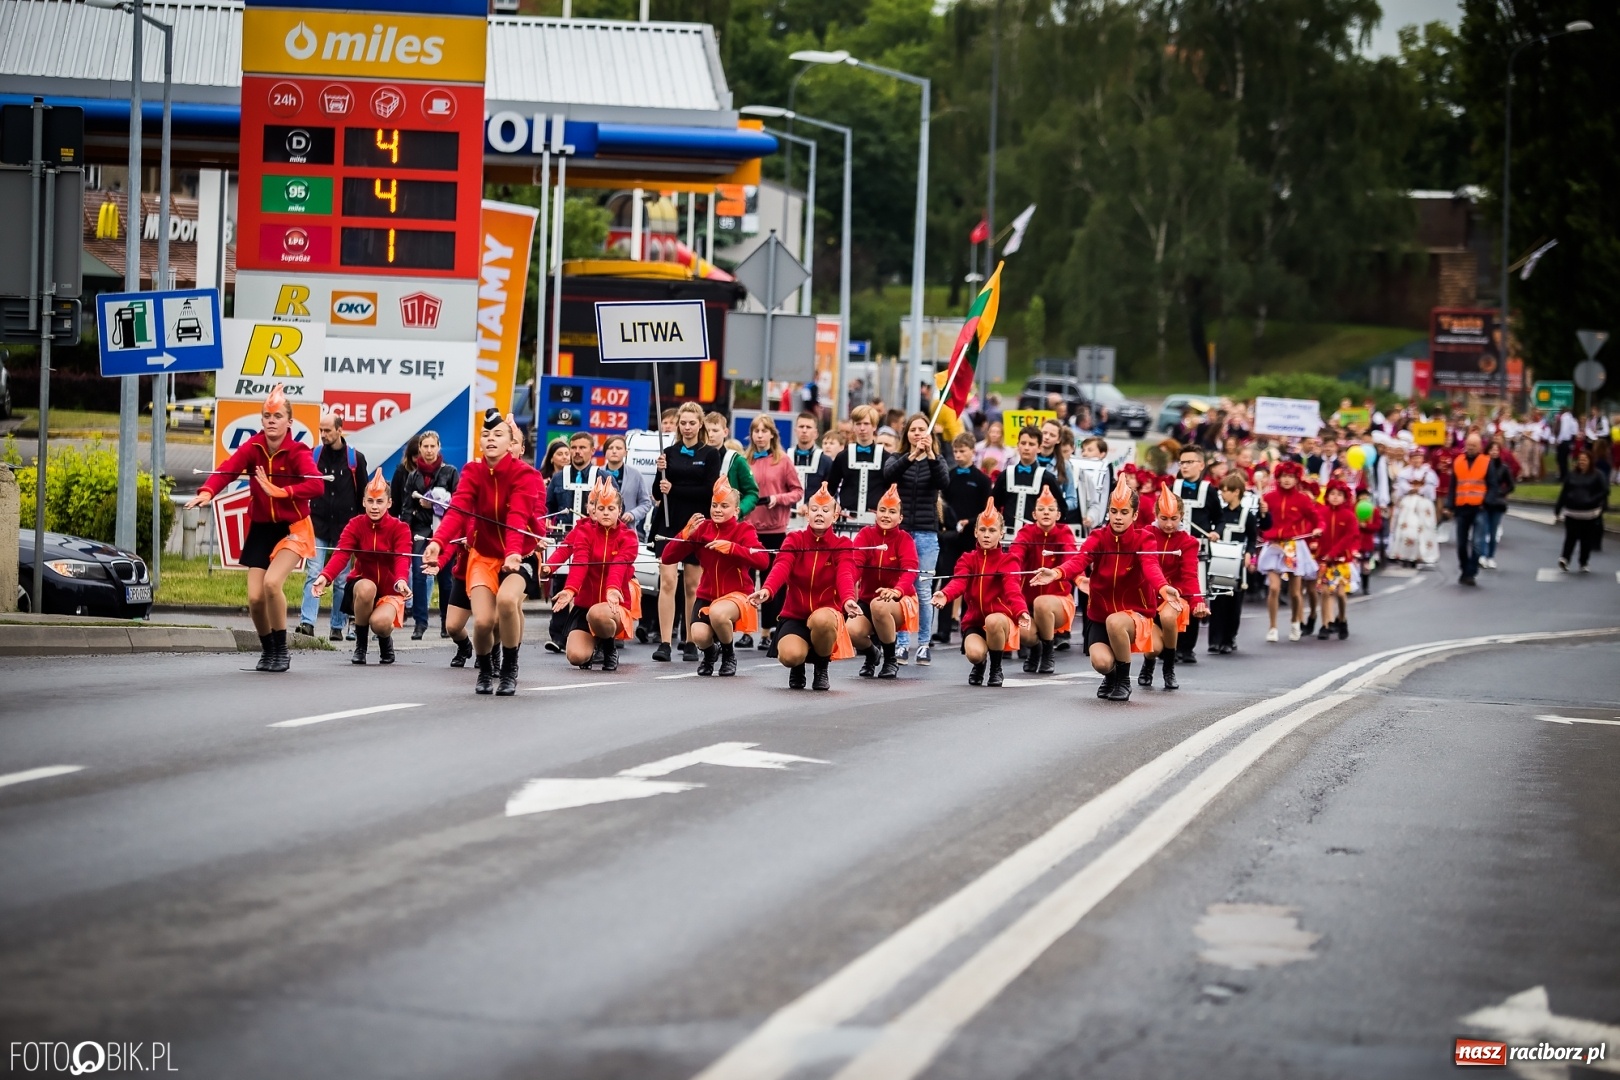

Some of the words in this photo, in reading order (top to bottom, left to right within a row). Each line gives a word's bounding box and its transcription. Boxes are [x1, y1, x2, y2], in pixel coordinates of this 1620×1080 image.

[322, 24, 445, 66] miles
[273, 92, 297, 107] 24h
[291, 135, 307, 150] D
[484, 111, 576, 155] OIL
[376, 128, 399, 165] 4
[289, 155, 307, 164] miles
[288, 185, 306, 199] 95
[375, 178, 397, 214] 4
[287, 204, 306, 213] miles
[287, 237, 305, 246] LPG
[388, 228, 396, 264] 1
[336, 303, 372, 315] DKV
[401, 297, 441, 328] UTA
[475, 233, 514, 413] WITAMY
[620, 321, 684, 343] LITWA
[399, 359, 445, 381] SIĘ!
[590, 387, 630, 406] 4,07
[589, 410, 629, 429] 4,32
